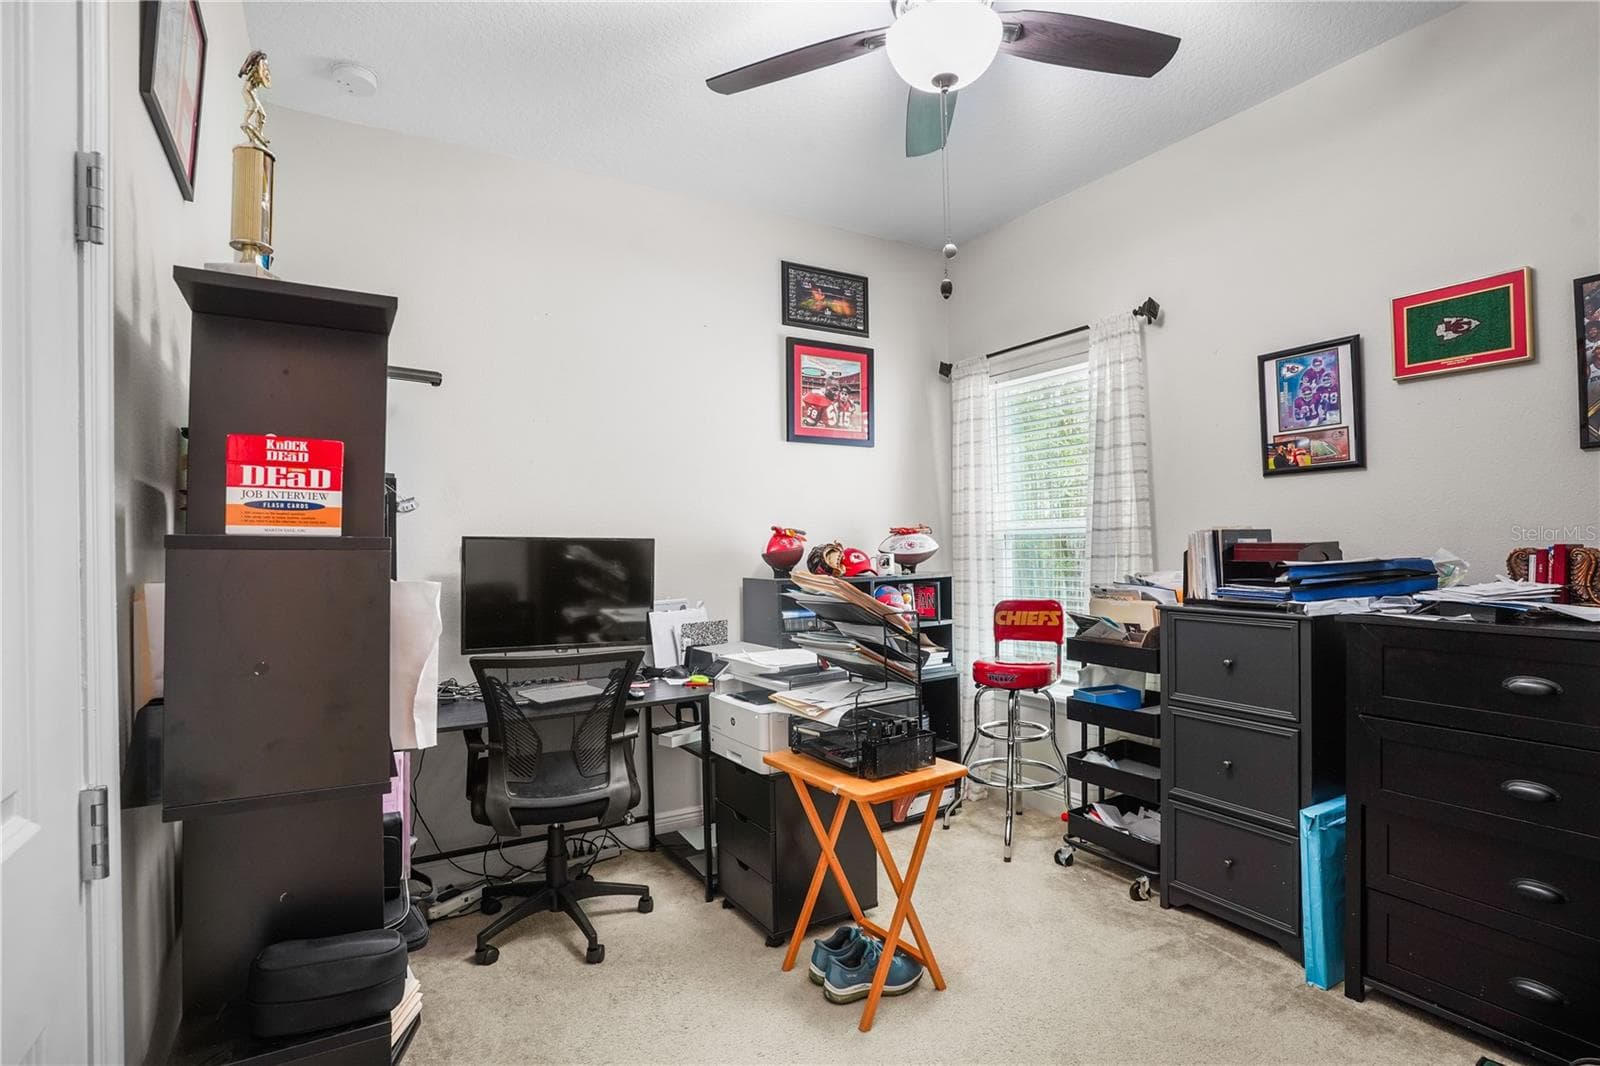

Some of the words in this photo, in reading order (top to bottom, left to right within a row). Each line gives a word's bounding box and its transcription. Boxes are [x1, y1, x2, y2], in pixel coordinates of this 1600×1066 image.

[239, 489, 263, 500] JOB
[266, 490, 330, 501] INTERVIEW
[263, 501, 284, 509] FLASH
[287, 502, 309, 510] CARDS
[995, 611, 1061, 626] CHIEFS
